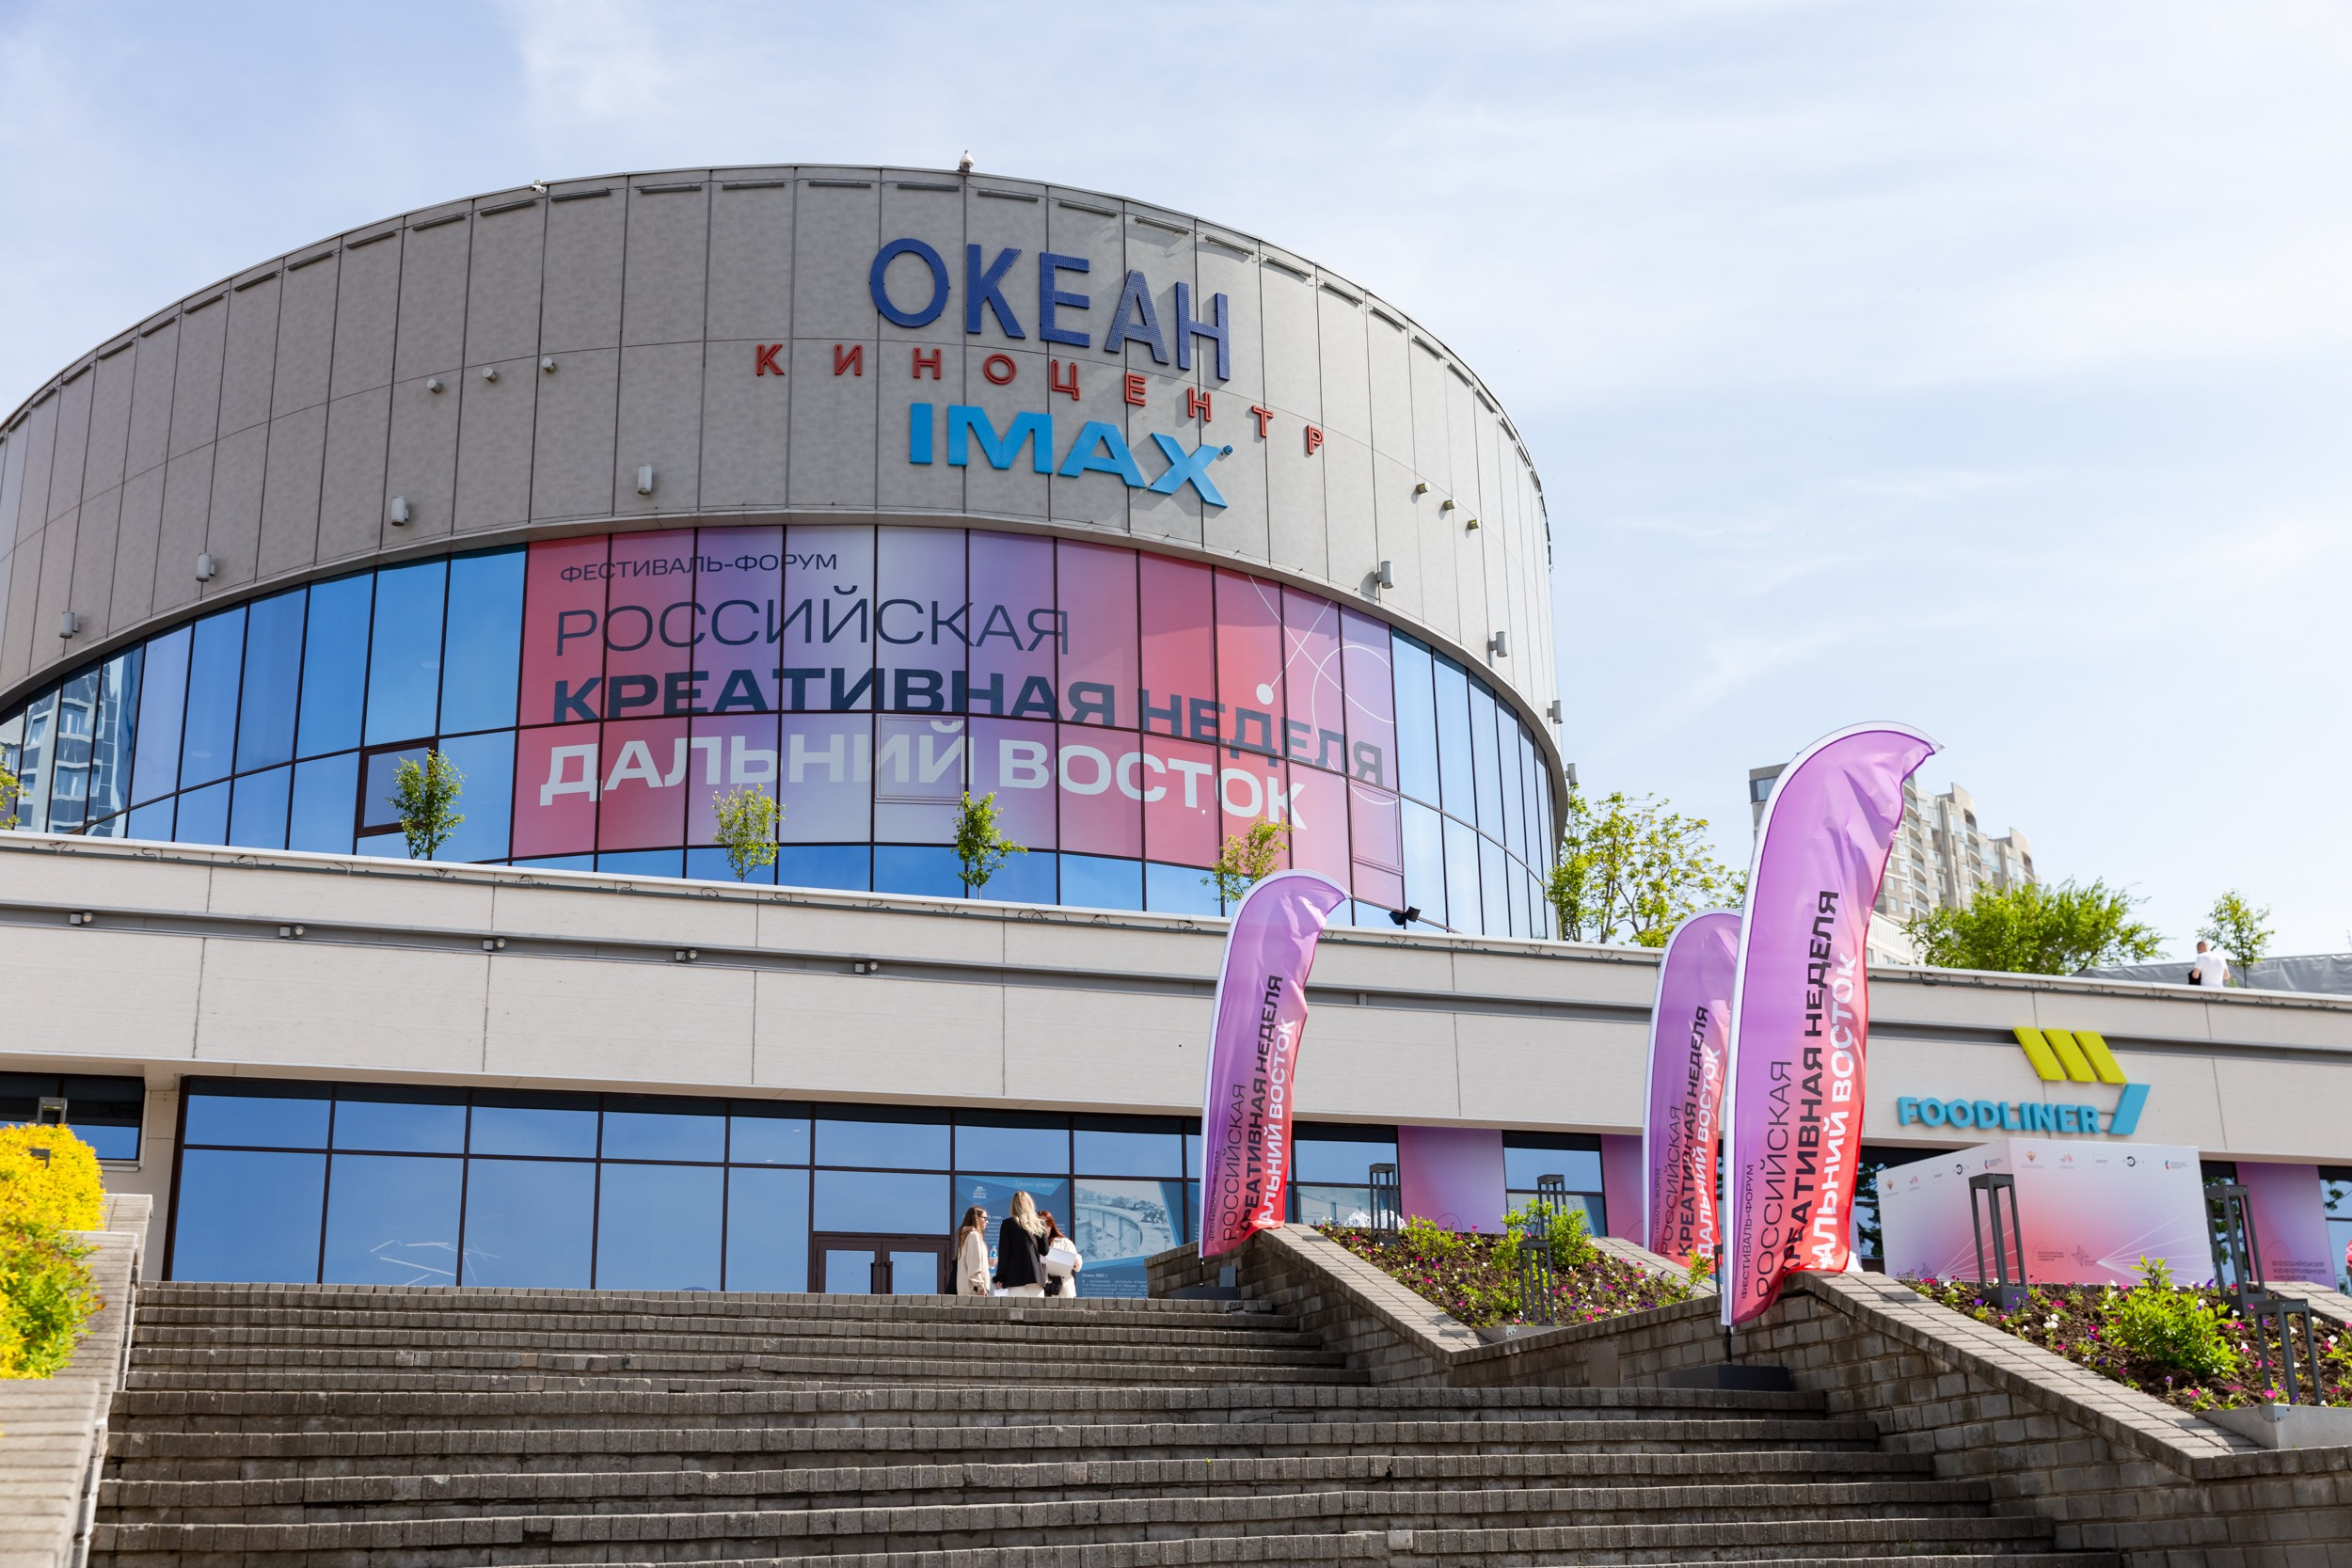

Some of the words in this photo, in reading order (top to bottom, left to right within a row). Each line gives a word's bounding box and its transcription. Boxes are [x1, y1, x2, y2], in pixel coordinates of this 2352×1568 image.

[869, 238, 1231, 381] ОКЕАН
[755, 344, 1324, 454] КИНОЦЕНТР
[557, 585, 1069, 657] РОССИЙСКАЯ
[561, 553, 837, 582] ФЕСТИВАЛЬ-ФОРУМ
[539, 720, 975, 807] ДАЛЬНИЙ
[999, 739, 1308, 830] ВОСТОК
[553, 667, 1116, 726] КРЕАТИВНАЯ
[1138, 688, 1384, 787] НЕДЕЛЯ
[1804, 891, 1839, 1037] НЕДЕЛЯ
[1255, 974, 1283, 1074] НЕДЕЛЯ
[1268, 1017, 1295, 1119] ВОСТОК
[1677, 1101, 1697, 1257] КРЕАТИВНАЯ
[1687, 1006, 1708, 1099] НЕДЕЛЯ
[1697, 1047, 1721, 1143] ВОСТОК
[1804, 1111, 1850, 1269] АЛЬНИЙ
[1830, 952, 1857, 1102] ВОСТОК
[1897, 1095, 2102, 1134] FOODLINER
[1222, 1084, 1247, 1241] РОССИЙСКАЯ
[1257, 1123, 1283, 1226] АЛЬНИЙ
[1661, 1106, 1682, 1256] РОССИЙСКАЯ
[1692, 1147, 1715, 1259] ДАЛЬНИЙ
[1756, 1061, 1792, 1298] РОССИЙСКАЯ
[1741, 1164, 1755, 1300] ФЕСТИВАЛЬ-ФОРУМ
